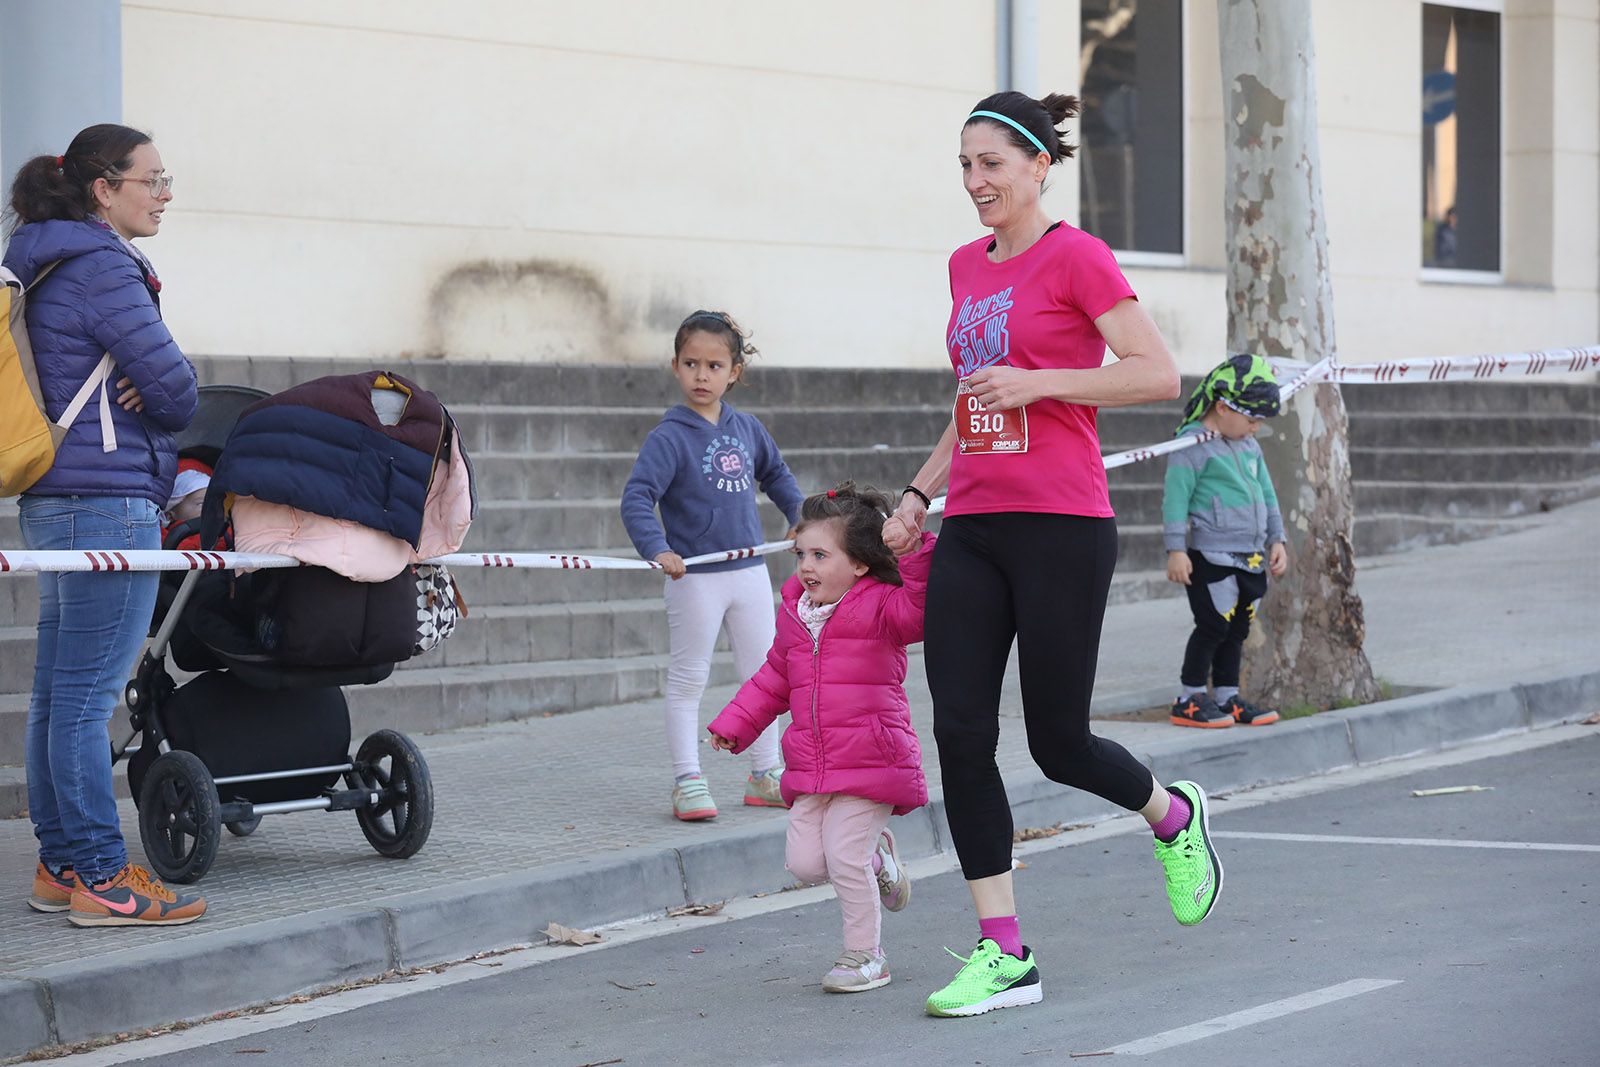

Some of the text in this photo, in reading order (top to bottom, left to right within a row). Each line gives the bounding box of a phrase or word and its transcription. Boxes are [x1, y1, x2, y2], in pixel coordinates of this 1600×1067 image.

[984, 312, 1009, 356] UAB
[970, 413, 1004, 434] 510
[720, 454, 741, 472] 22
